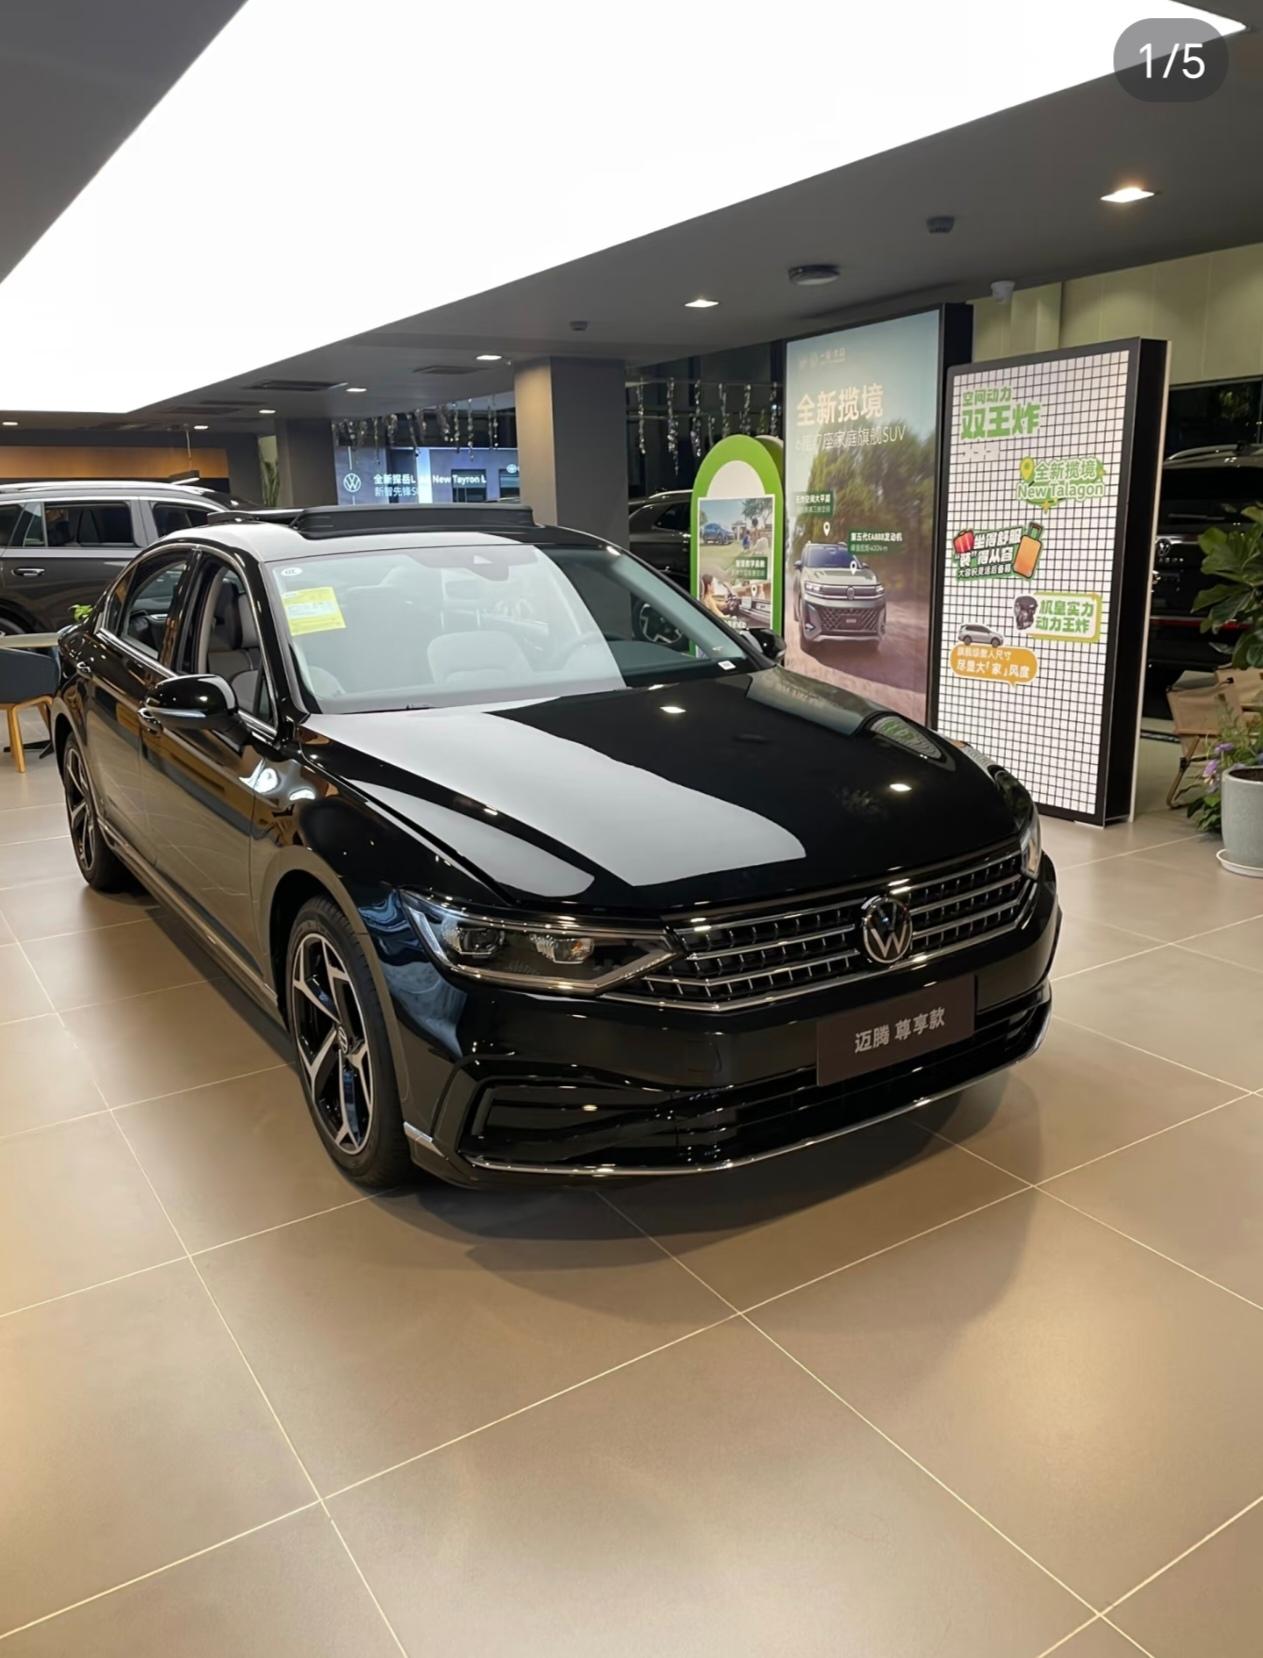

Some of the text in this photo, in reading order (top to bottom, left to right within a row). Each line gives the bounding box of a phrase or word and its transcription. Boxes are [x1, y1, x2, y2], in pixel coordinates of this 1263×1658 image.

[796, 383, 884, 427] 全新揽境
[962, 386, 1012, 406] 空间动力
[960, 401, 1041, 440] 双王炸
[433, 474, 450, 484] New
[1035, 459, 1097, 480] 全新揽境
[1016, 483, 1104, 499] New Talagon
[1035, 616, 1090, 634] 动力王炸
[854, 1006, 946, 1054] 迈腾 尊享款
